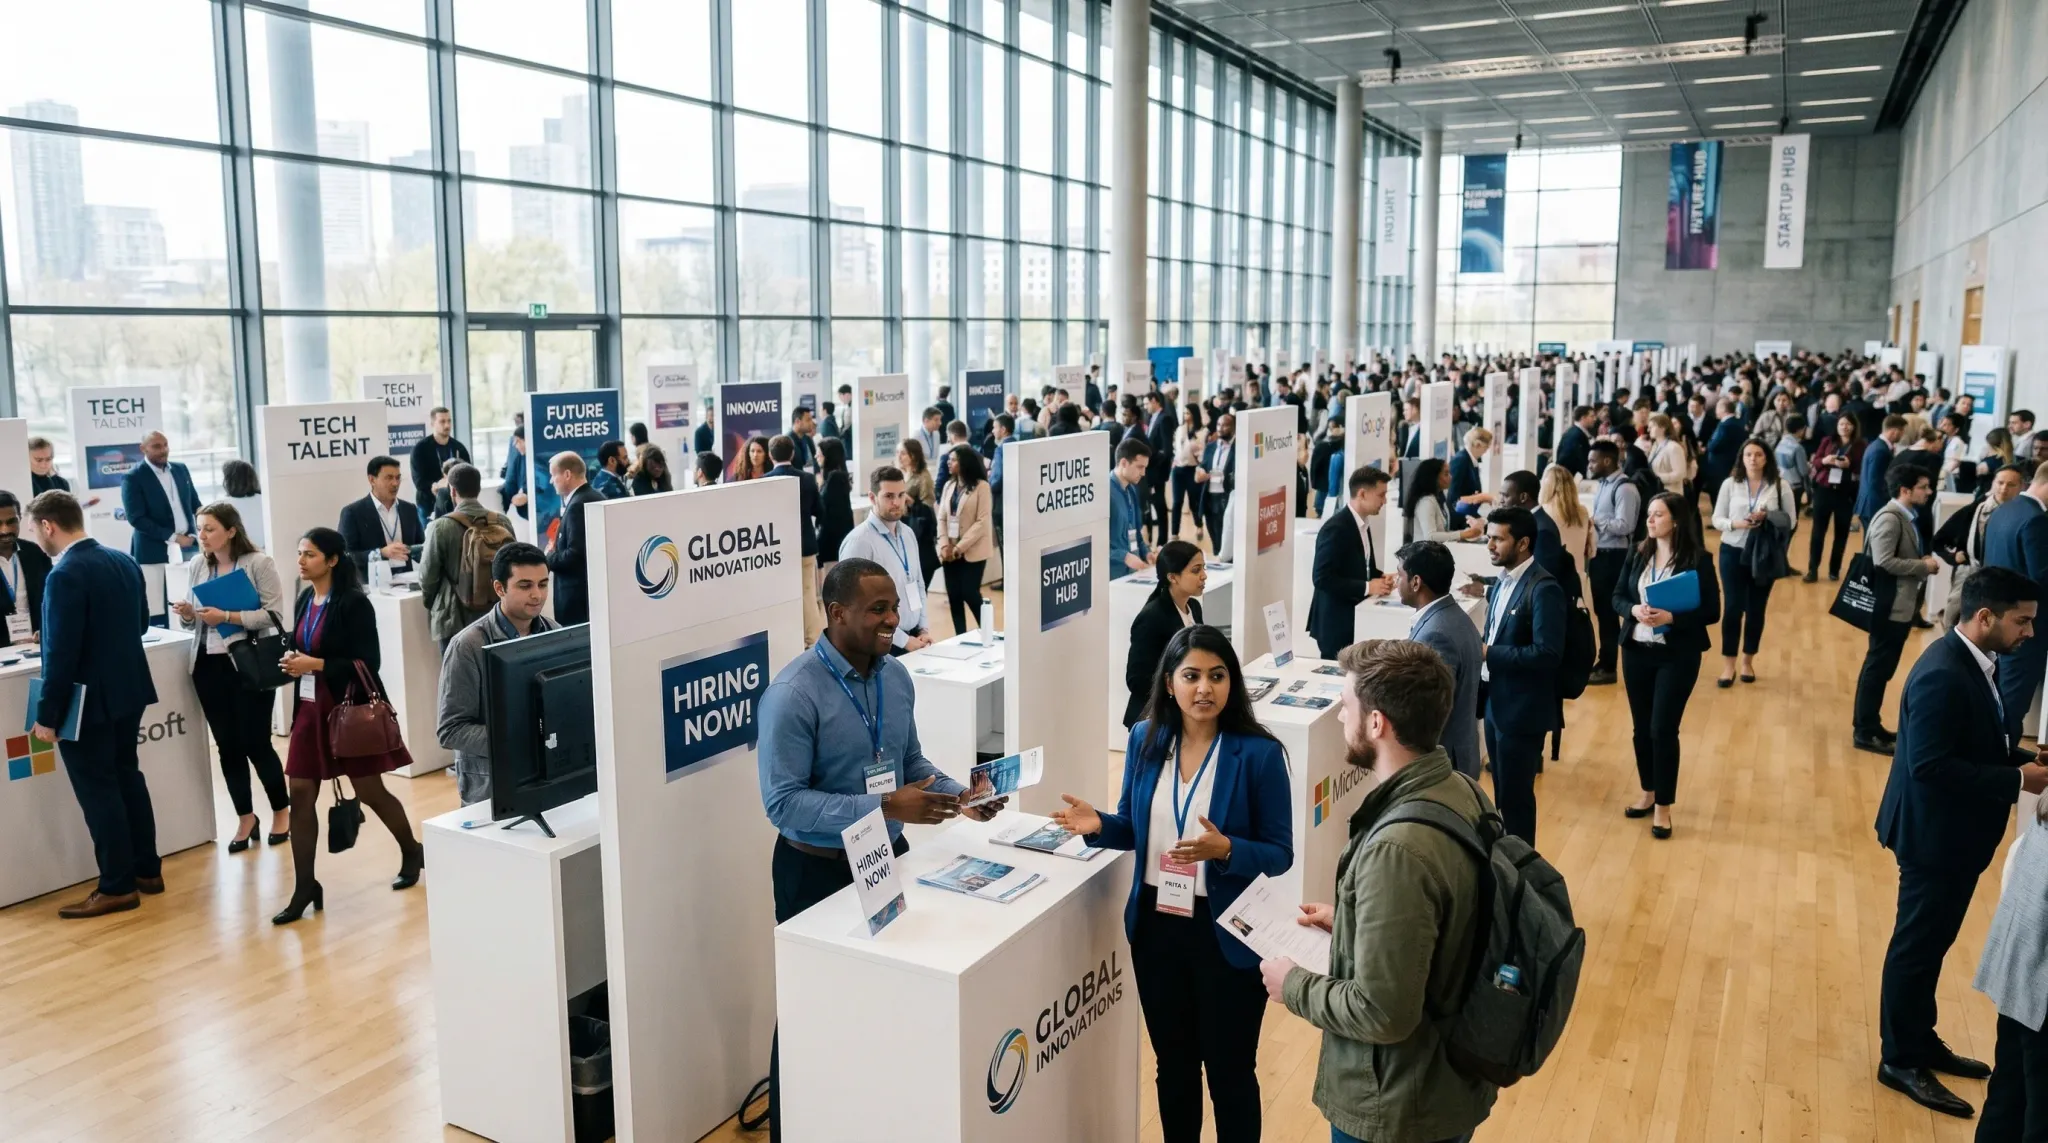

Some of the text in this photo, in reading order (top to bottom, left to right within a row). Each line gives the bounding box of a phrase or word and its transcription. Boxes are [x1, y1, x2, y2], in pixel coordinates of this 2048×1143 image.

[1777, 145, 1797, 249] STARTUP HUB
[382, 383, 415, 395] TECH
[87, 398, 145, 416] TECH
[547, 403, 604, 421] FUTURE
[726, 400, 779, 416] INNOVATE
[92, 416, 145, 429] TALENT
[299, 416, 356, 436] TECH
[543, 421, 609, 440] CAREERS
[288, 438, 370, 460] TALENT
[1265, 430, 1292, 451] Microsoft
[1040, 457, 1091, 486] FUTURE
[1036, 482, 1094, 514] CAREERS
[687, 522, 781, 561] GLOBAL
[689, 551, 782, 584] INNOVATIONS
[1043, 557, 1090, 587] STARTUP
[1055, 582, 1079, 605] HUB
[673, 663, 760, 714] HIRING
[684, 698, 752, 745] NOW!
[856, 843, 889, 875] HIRING
[864, 862, 891, 890] NOW!
[1035, 950, 1122, 1044] GLOBAL
[1036, 982, 1123, 1074] INNOVATIONS
